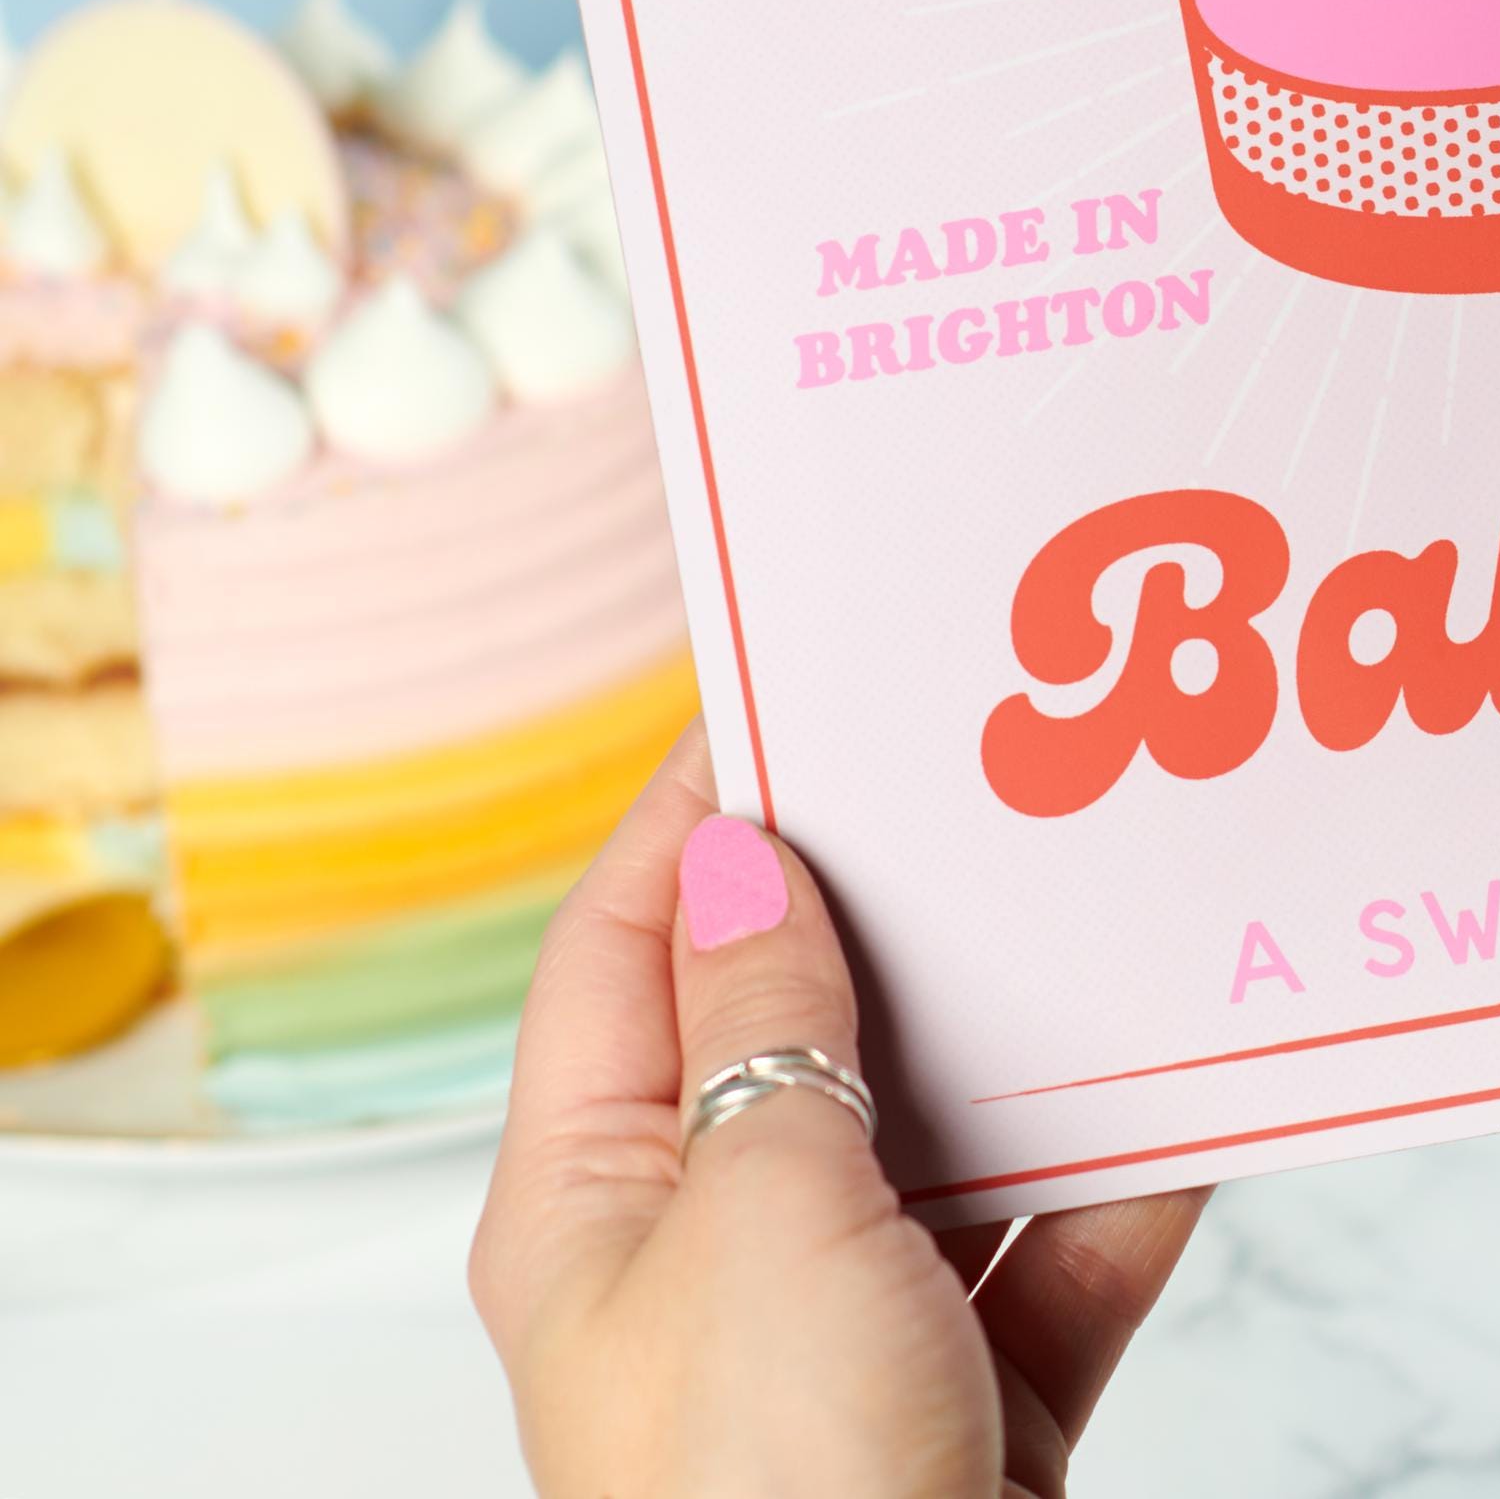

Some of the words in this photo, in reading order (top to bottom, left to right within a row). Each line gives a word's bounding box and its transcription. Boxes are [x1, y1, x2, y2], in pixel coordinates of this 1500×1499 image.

[817, 206, 1051, 298] MADE
[1072, 189, 1162, 254] IN
[795, 269, 1214, 388] BRIGHTON
[1230, 922, 1306, 1003] A
